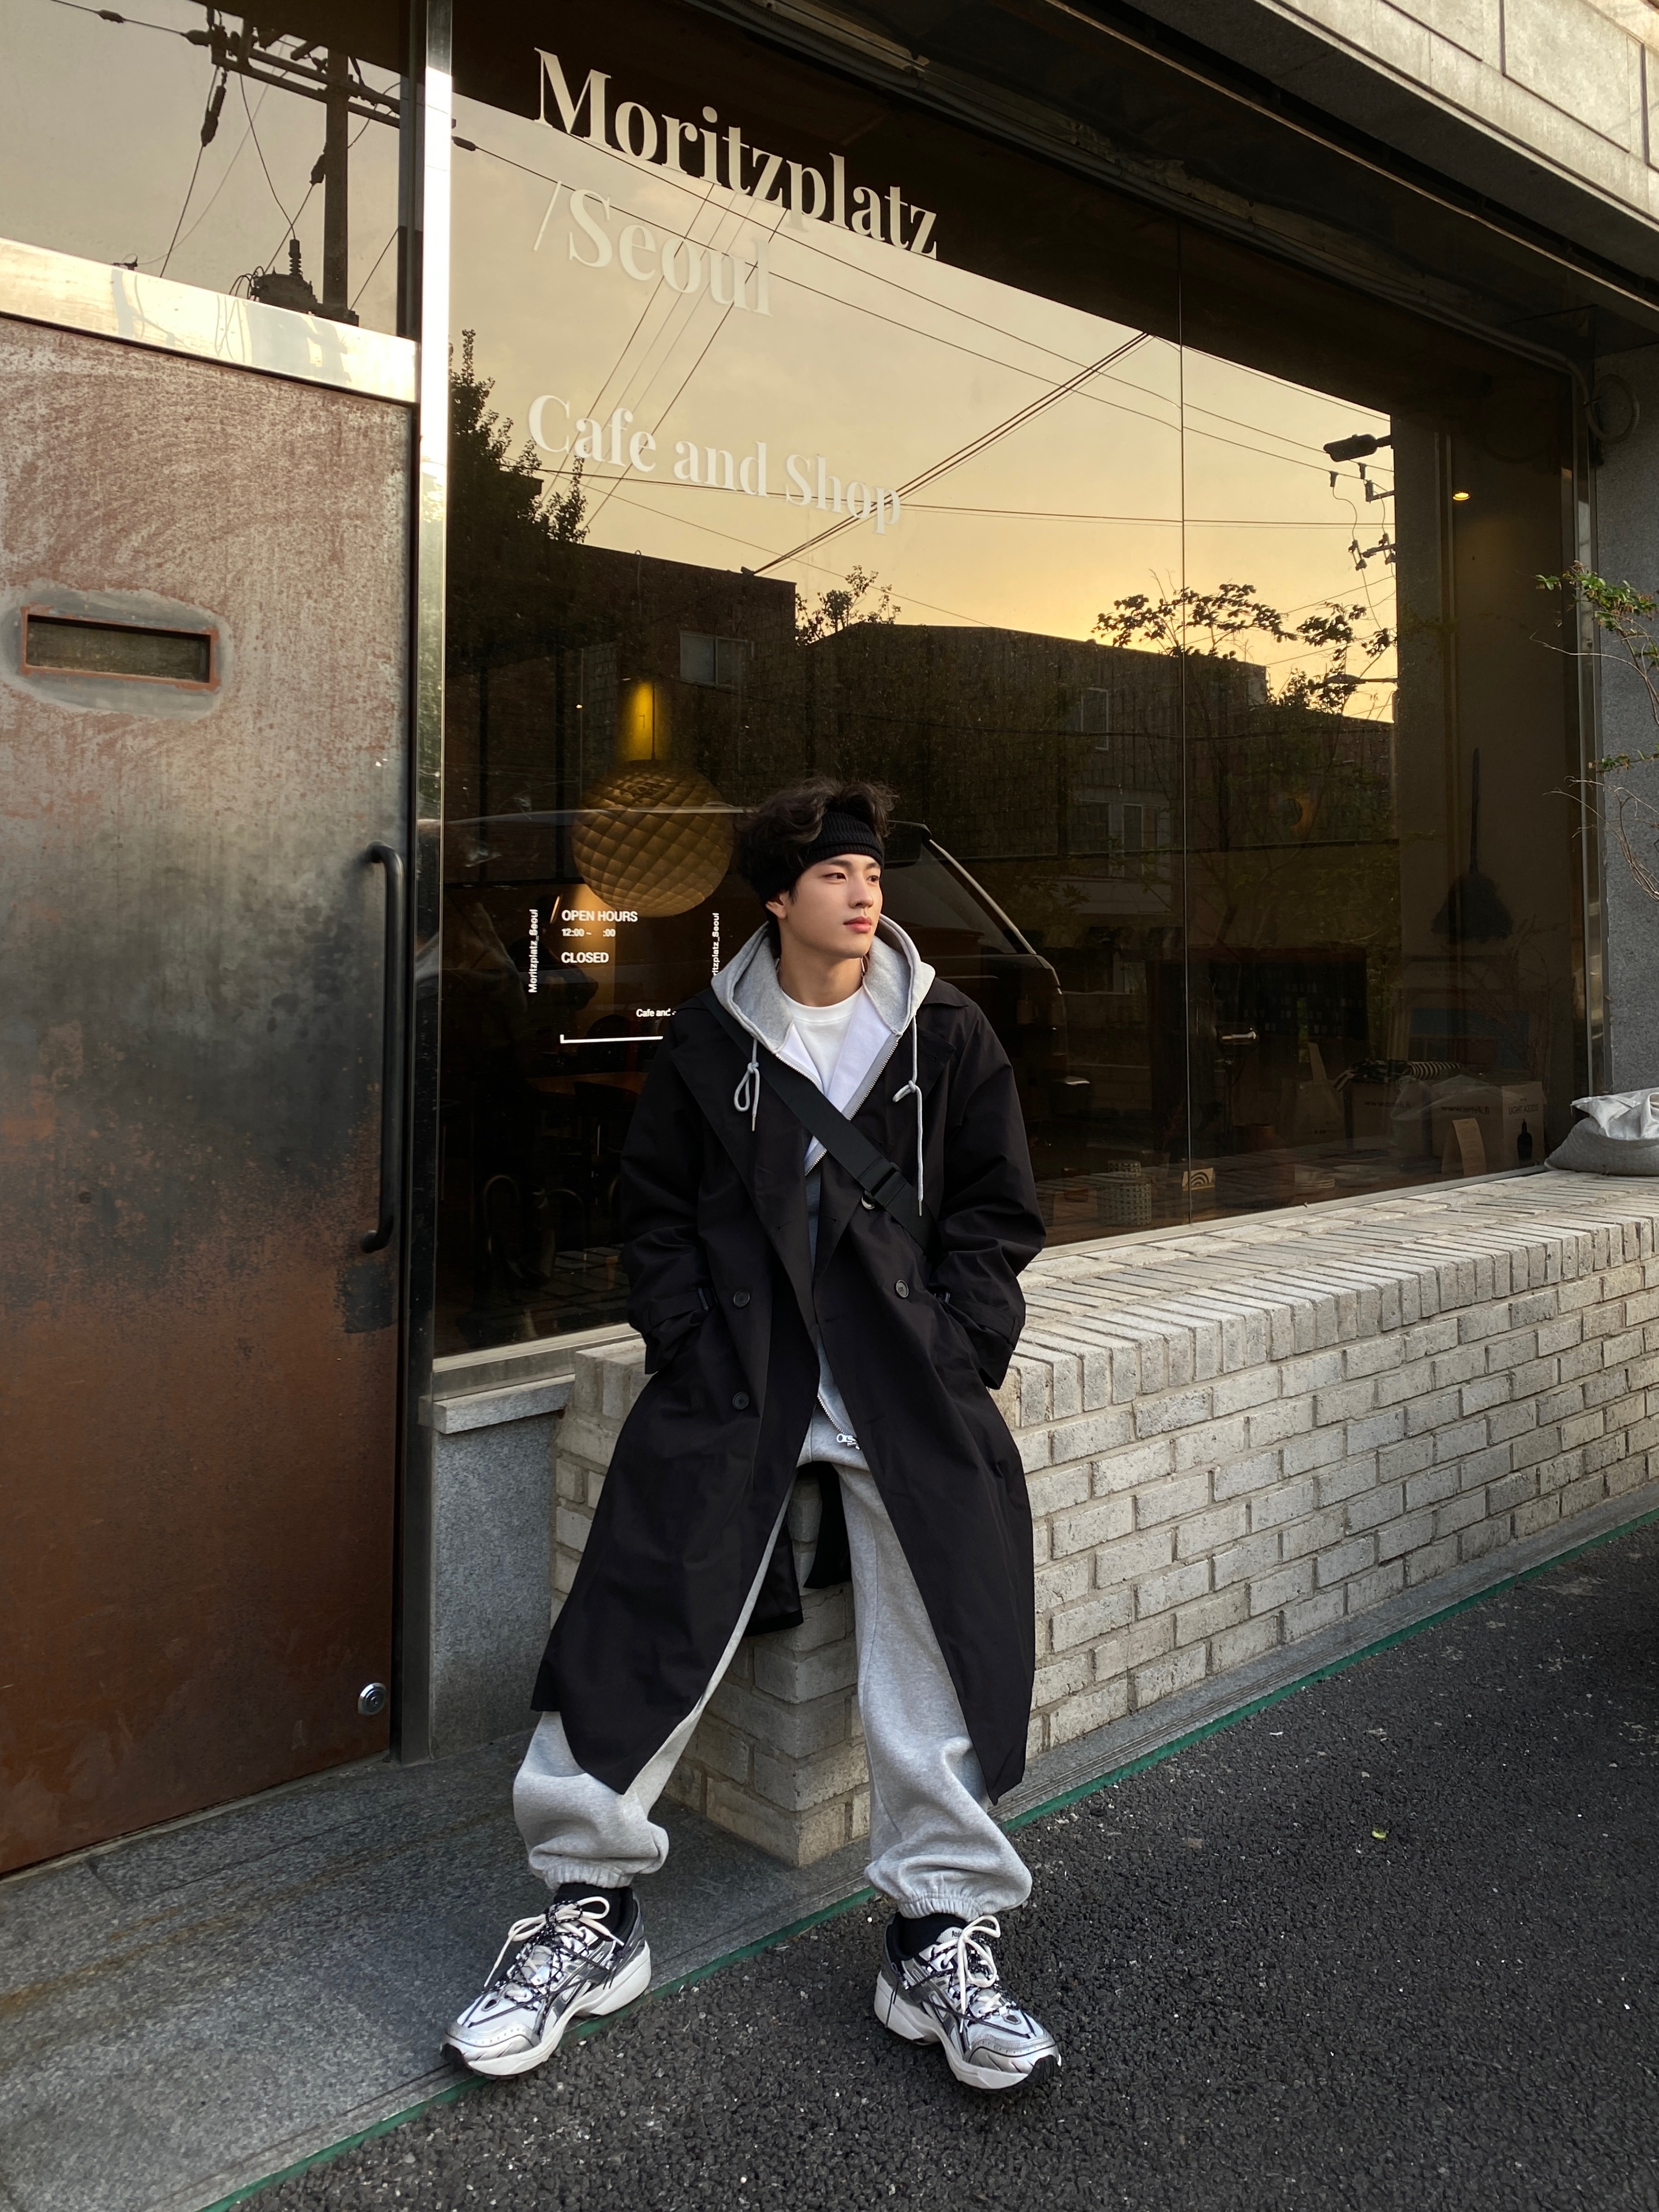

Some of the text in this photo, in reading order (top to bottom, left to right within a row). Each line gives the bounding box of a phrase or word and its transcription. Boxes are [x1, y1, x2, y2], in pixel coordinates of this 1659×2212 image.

[534, 47, 938, 259] Moritzplatz
[528, 395, 901, 536] Cafe and Shop
[561, 909, 638, 922] OPEN HOURS
[561, 928, 585, 937] 12:00
[711, 912, 720, 976] ritzplatz_Seoul
[561, 952, 609, 963] CLOSED
[636, 1008, 655, 1017] Cafe
